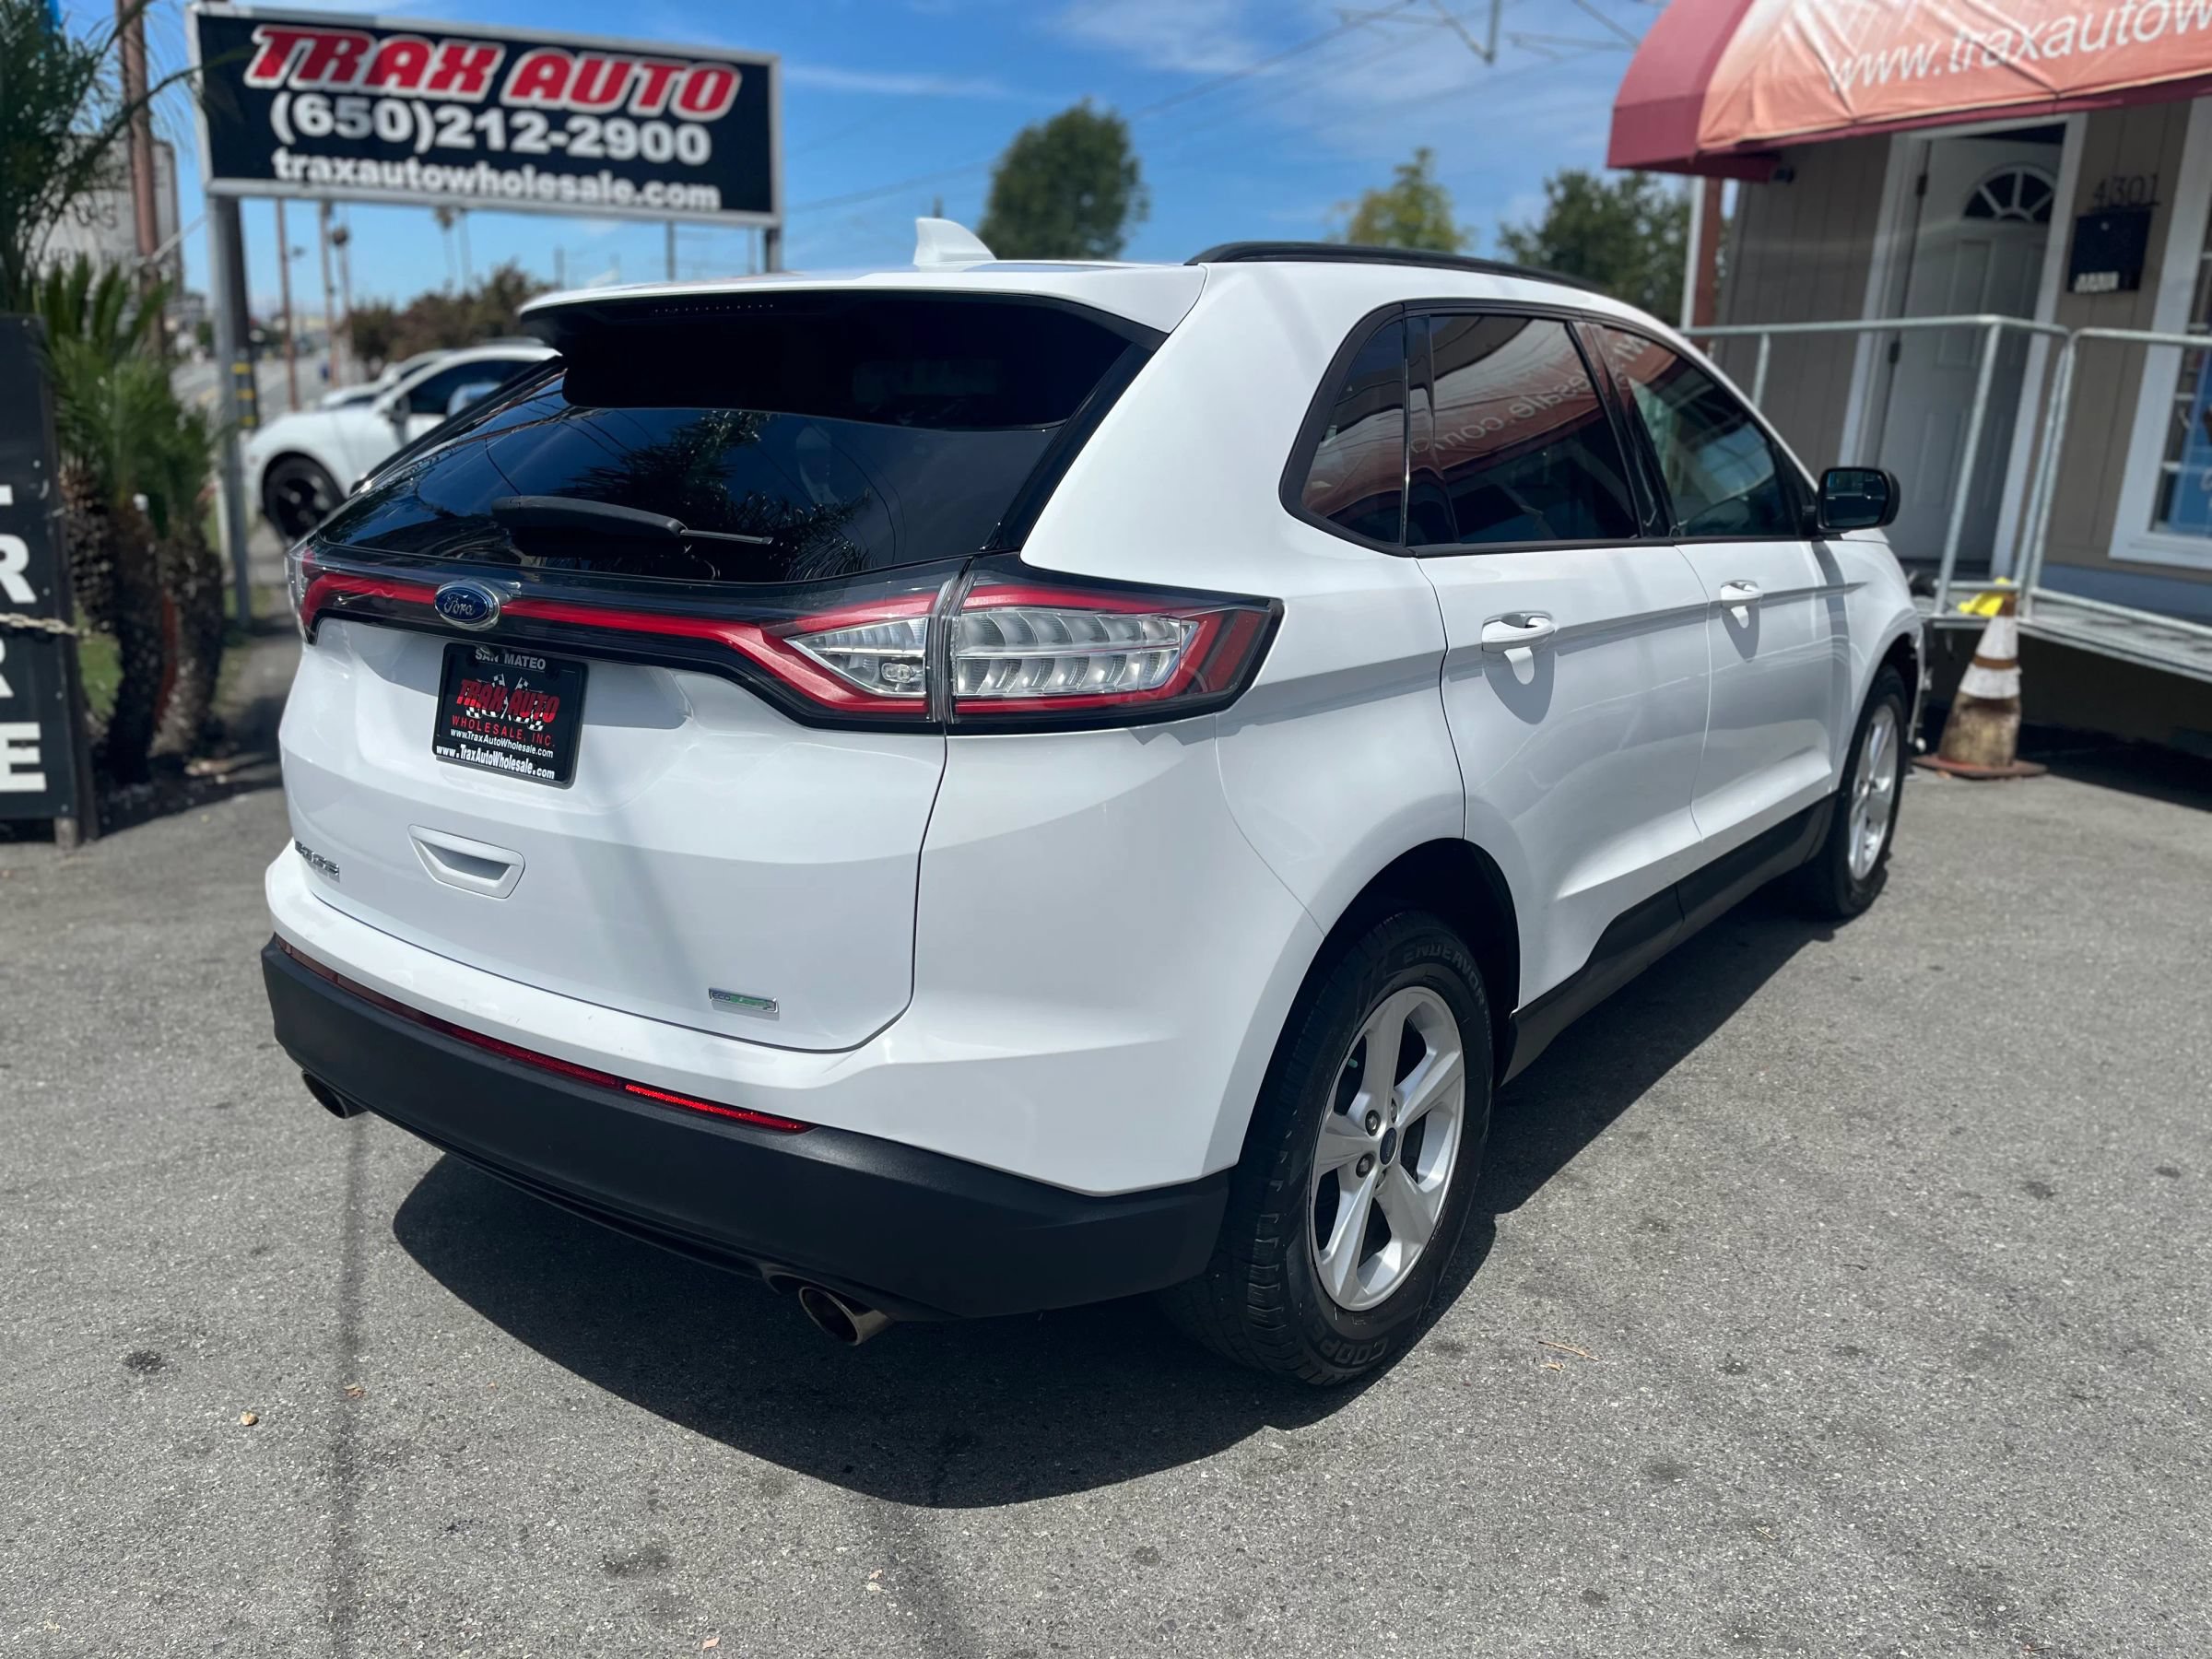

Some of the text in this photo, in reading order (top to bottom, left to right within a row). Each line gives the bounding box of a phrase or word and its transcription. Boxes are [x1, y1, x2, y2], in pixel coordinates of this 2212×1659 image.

[244, 24, 741, 121] TRAX AUTO
[270, 92, 712, 165] (650)212-2900
[271, 146, 720, 211] traxautowholesale.com
[443, 594, 476, 618] Ford
[504, 653, 546, 670] MATEO
[456, 679, 559, 723] TRAX AUTO
[436, 744, 556, 780] www.TraxAutoWholesale.com
